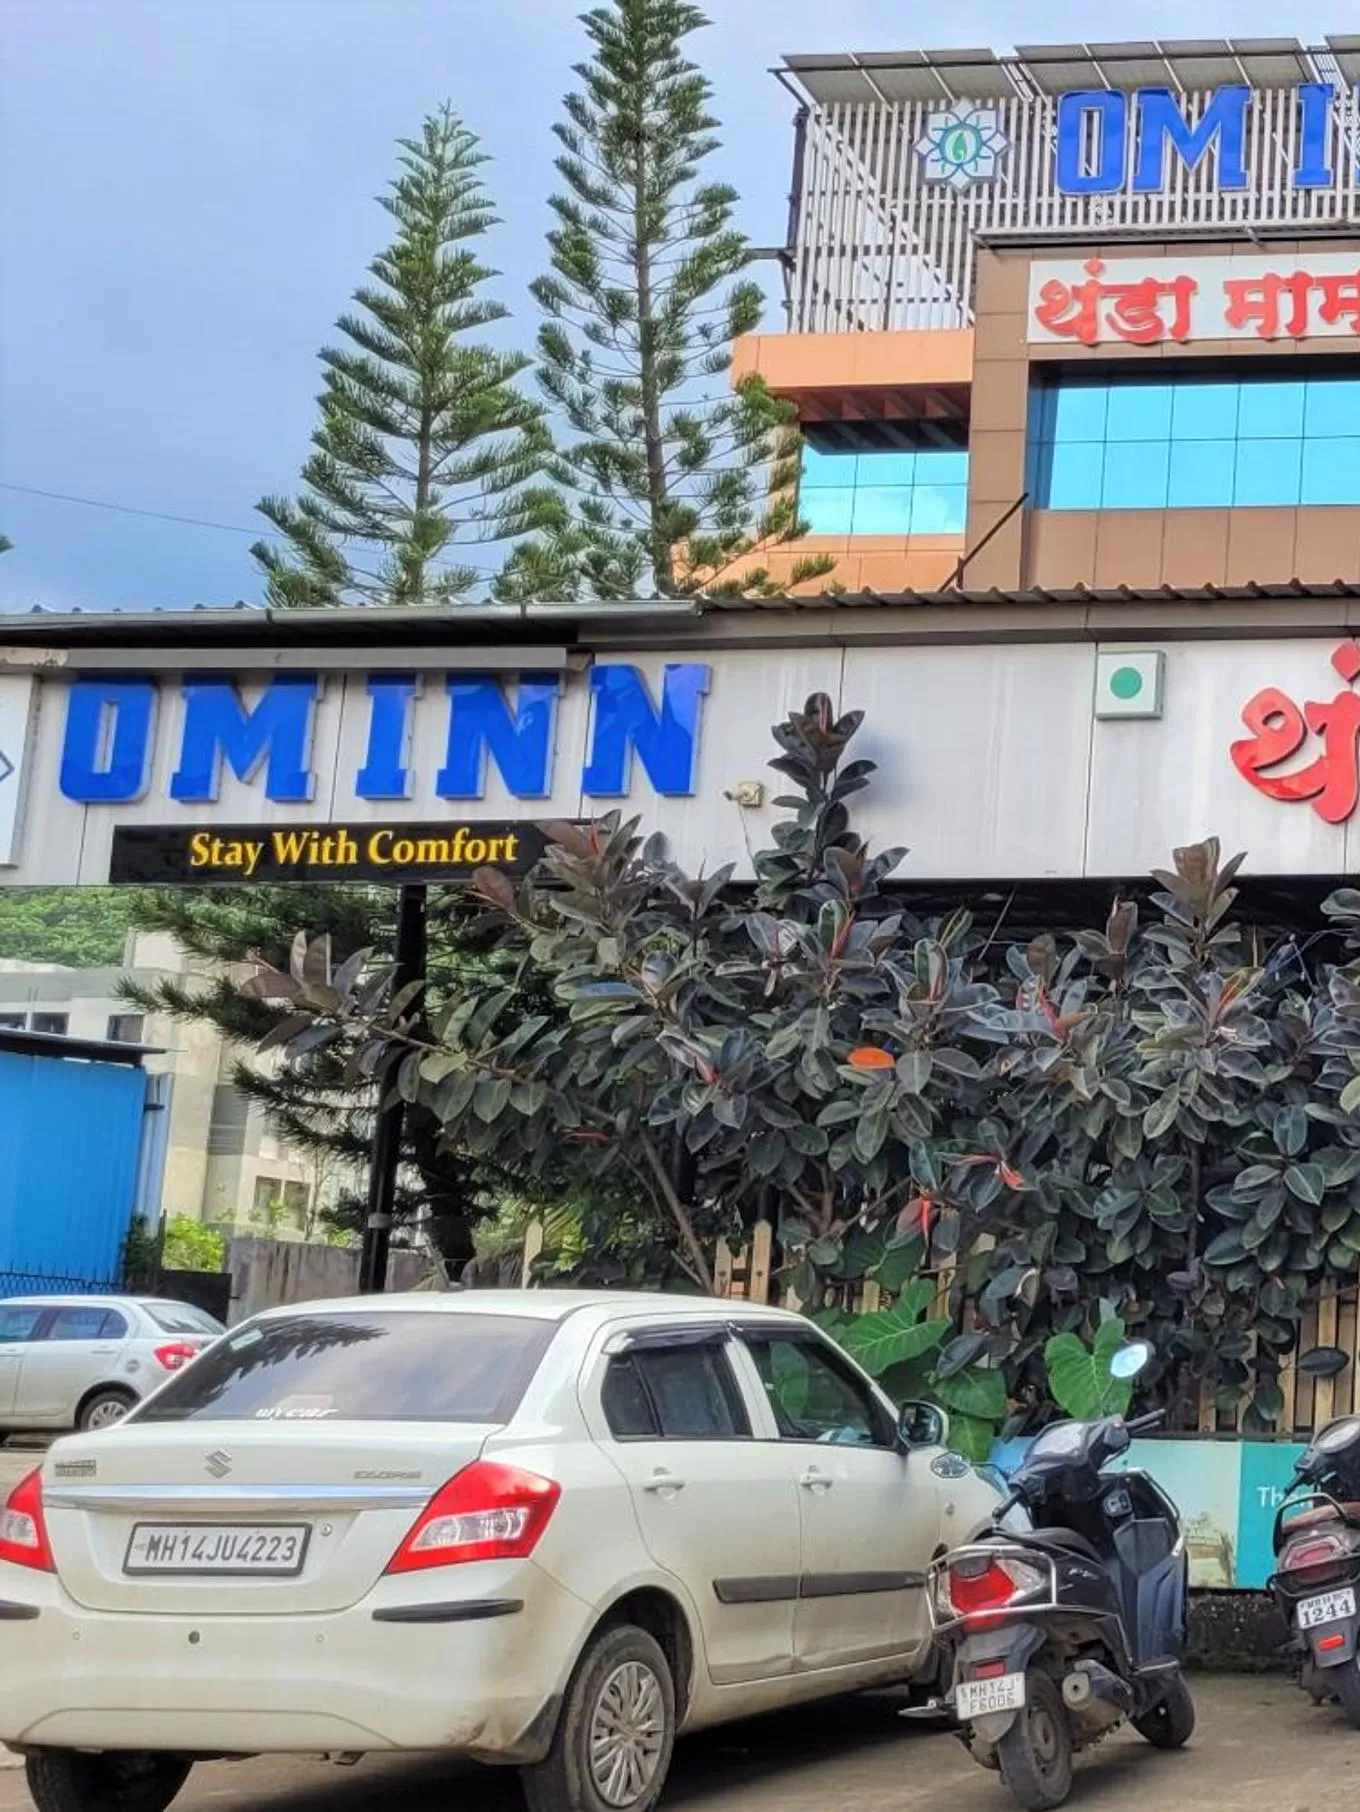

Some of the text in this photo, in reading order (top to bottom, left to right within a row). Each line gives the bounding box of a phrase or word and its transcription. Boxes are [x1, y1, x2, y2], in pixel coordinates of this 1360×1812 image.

[1055, 85, 1255, 196] OM
[1034, 257, 1197, 346] थंडा
[58, 663, 714, 806] OM INN
[190, 828, 519, 876] Stay With Comfort
[145, 1535, 298, 1562] MH14JU4223
[1303, 1600, 1351, 1626] 1244
